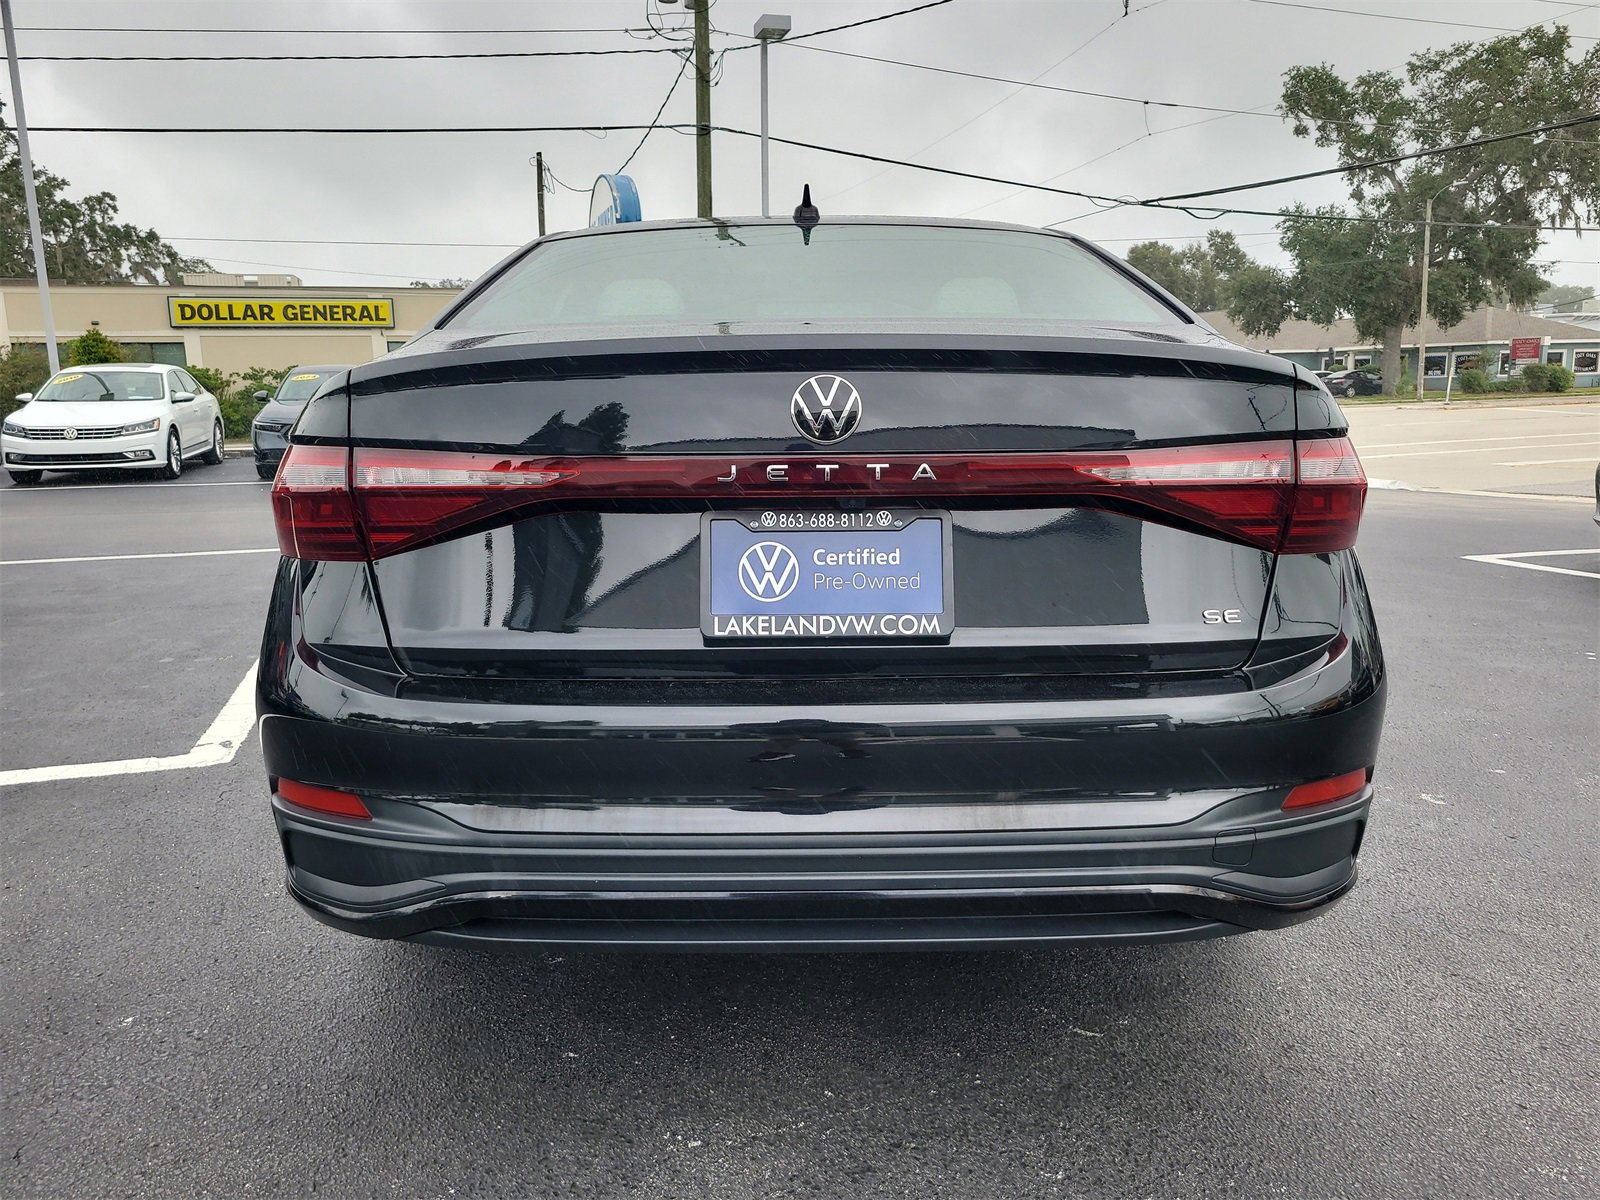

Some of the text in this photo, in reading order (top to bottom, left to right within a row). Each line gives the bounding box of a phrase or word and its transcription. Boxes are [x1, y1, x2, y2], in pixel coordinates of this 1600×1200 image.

[178, 303, 387, 322] DOLLAR GENERAL
[791, 374, 863, 445] VW
[717, 462, 937, 482] JETTA
[761, 510, 892, 528] VW 863-688-8112 VW
[813, 548, 901, 566] Certified
[738, 541, 800, 603] VW
[813, 572, 921, 590] Pre-Owned
[713, 615, 941, 635] LAKELANDVW.COM
[1202, 609, 1242, 624] SE
